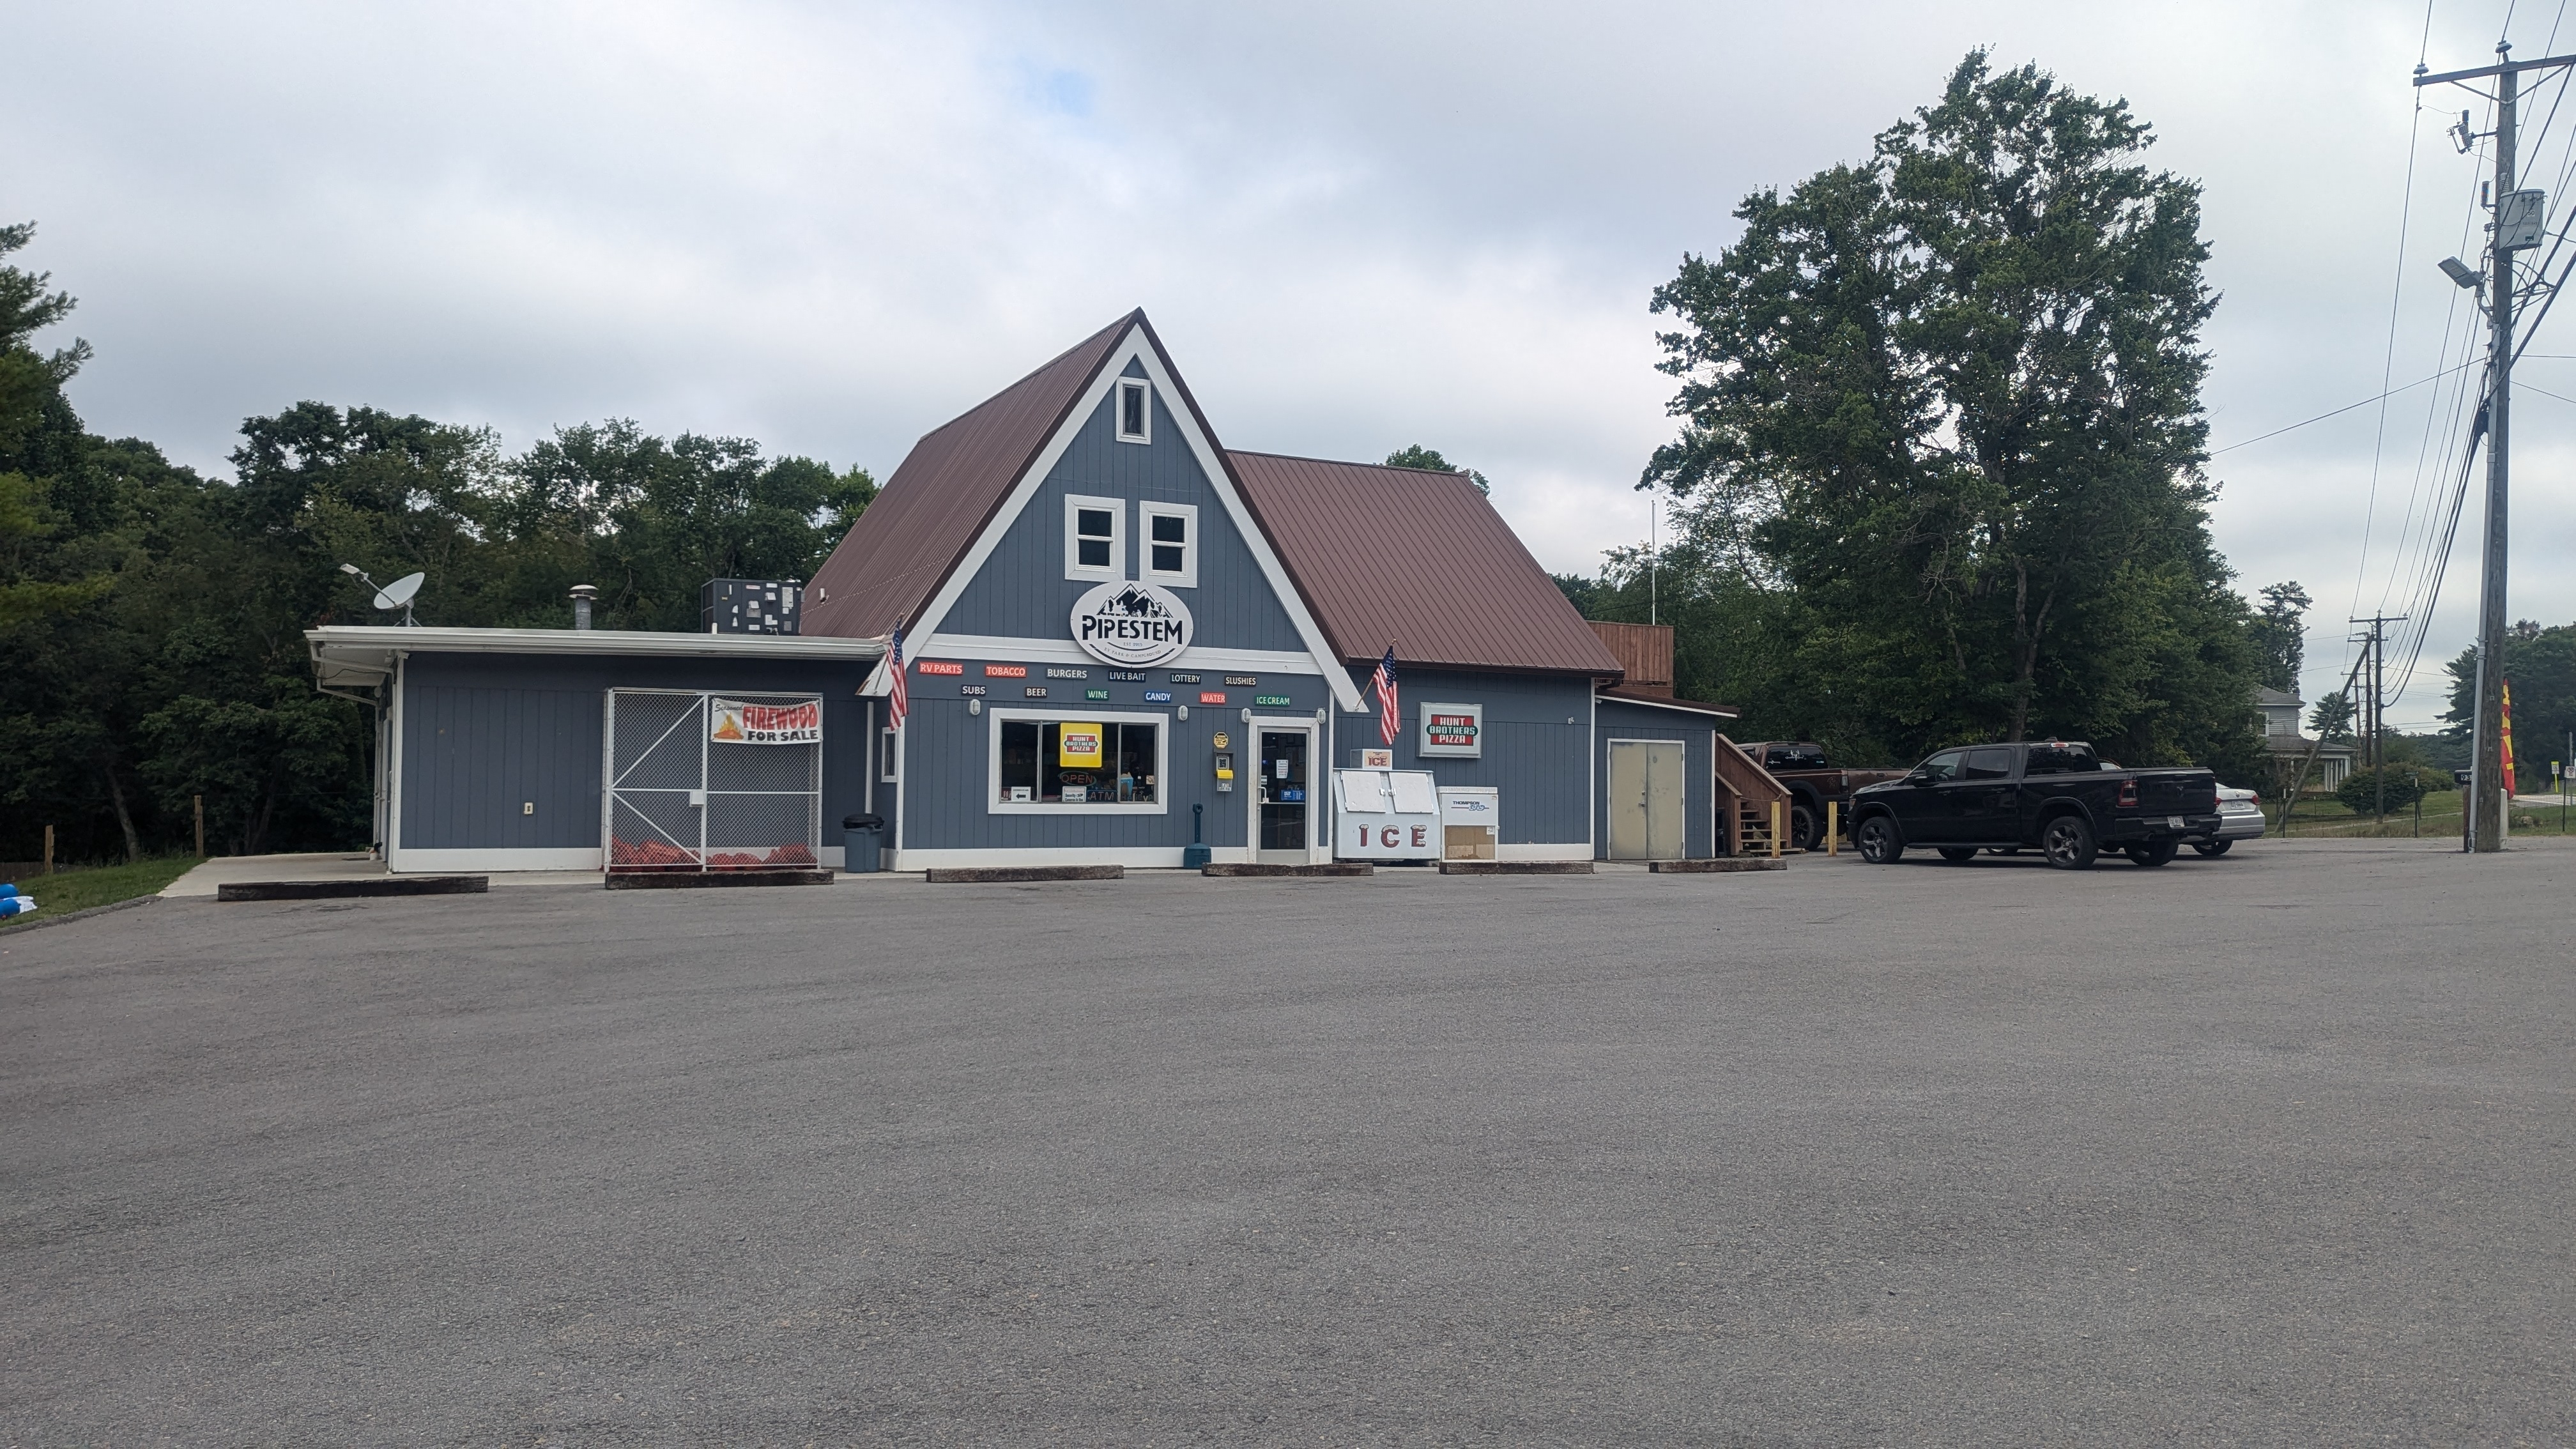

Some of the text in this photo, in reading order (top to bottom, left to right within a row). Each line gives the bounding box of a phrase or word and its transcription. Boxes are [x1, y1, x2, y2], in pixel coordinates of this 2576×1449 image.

[1082, 615, 1183, 645] PIPESTEM
[1131, 650, 1162, 658] CAMPGROUND
[920, 663, 963, 674] RV PARTS
[986, 666, 1026, 676] TOBACCO
[1047, 668, 1087, 678] BURGERS
[1109, 671, 1146, 681] LIVE BAIT
[1172, 674, 1200, 683] LOTTERY
[1225, 677, 1256, 686] SLUSHIES
[962, 686, 986, 694] SUBS
[1027, 688, 1046, 696] BEER
[1088, 691, 1108, 700] WINE
[1146, 692, 1171, 701] CANDY
[1201, 693, 1225, 703] WATER
[714, 703, 744, 712] Seasoned
[743, 704, 818, 730] FIREWOOD
[1439, 717, 1466, 726] HUNT
[1429, 726, 1475, 735] BROTHERS
[747, 730, 819, 742] FOR SALE
[1439, 734, 1466, 744] PIZZA
[1368, 755, 1387, 766] ICE
[1061, 774, 1093, 783] OPEN
[1090, 792, 1114, 801] ATM
[1359, 824, 1427, 848] ICE
